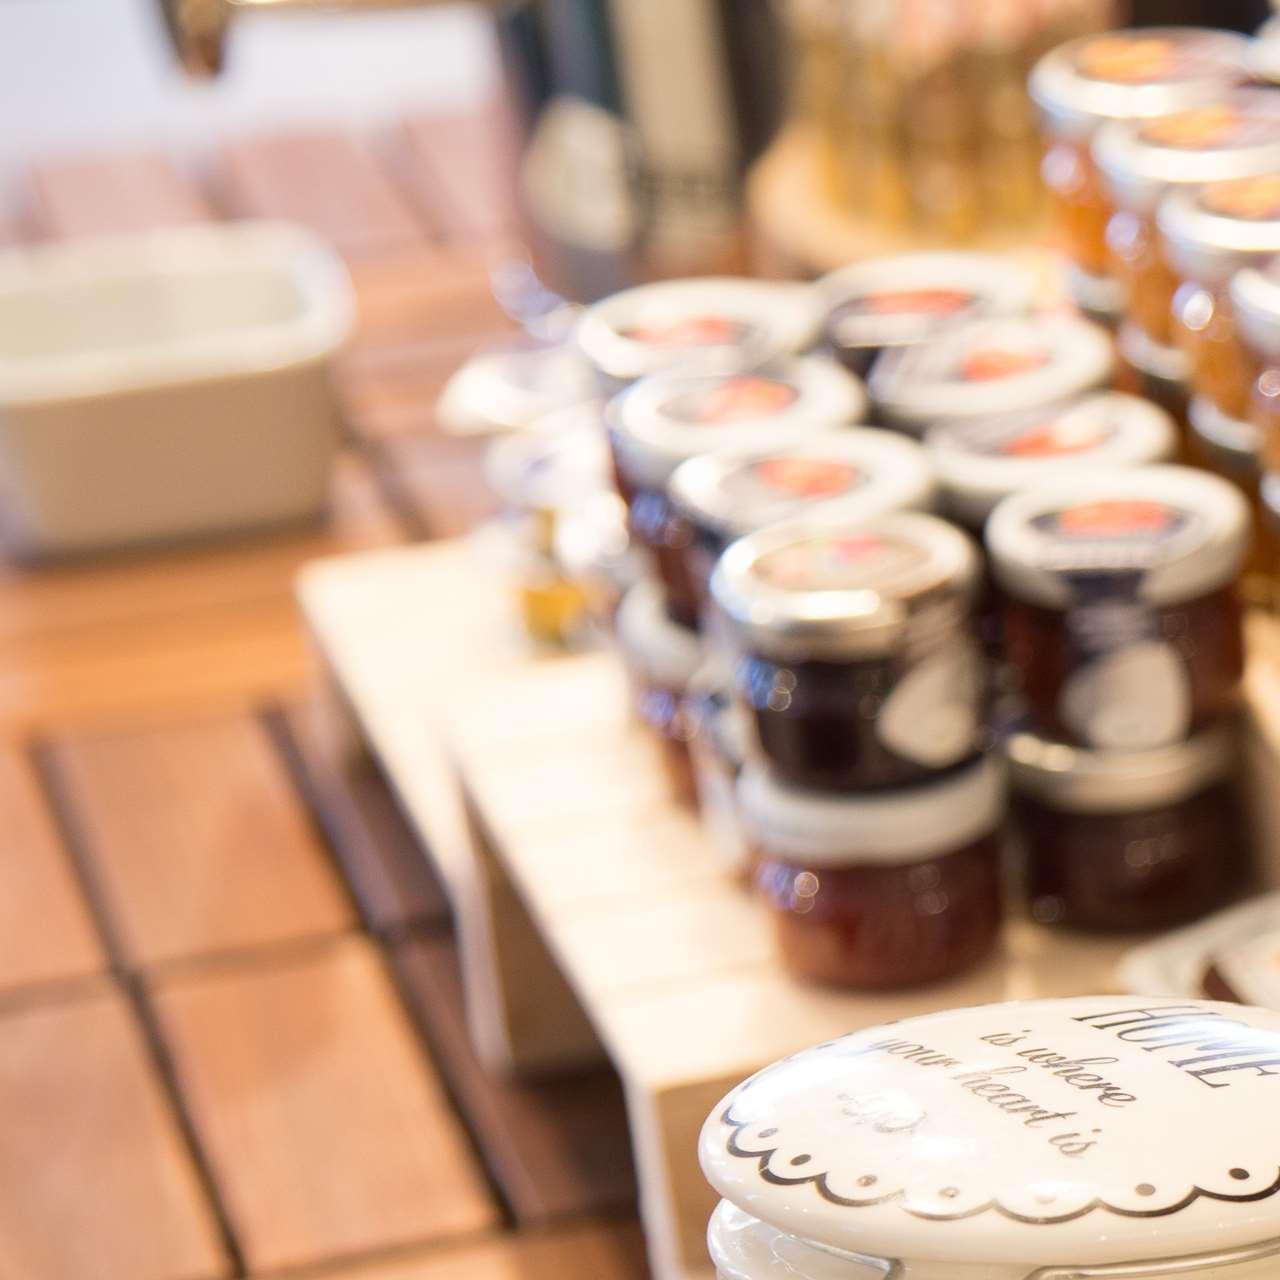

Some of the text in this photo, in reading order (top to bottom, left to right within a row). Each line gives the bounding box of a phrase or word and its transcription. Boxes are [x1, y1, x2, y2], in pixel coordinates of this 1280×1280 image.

[951, 1065, 1078, 1128] heart
[1047, 1128, 1103, 1158] is
[979, 1029, 1137, 1108] is where
